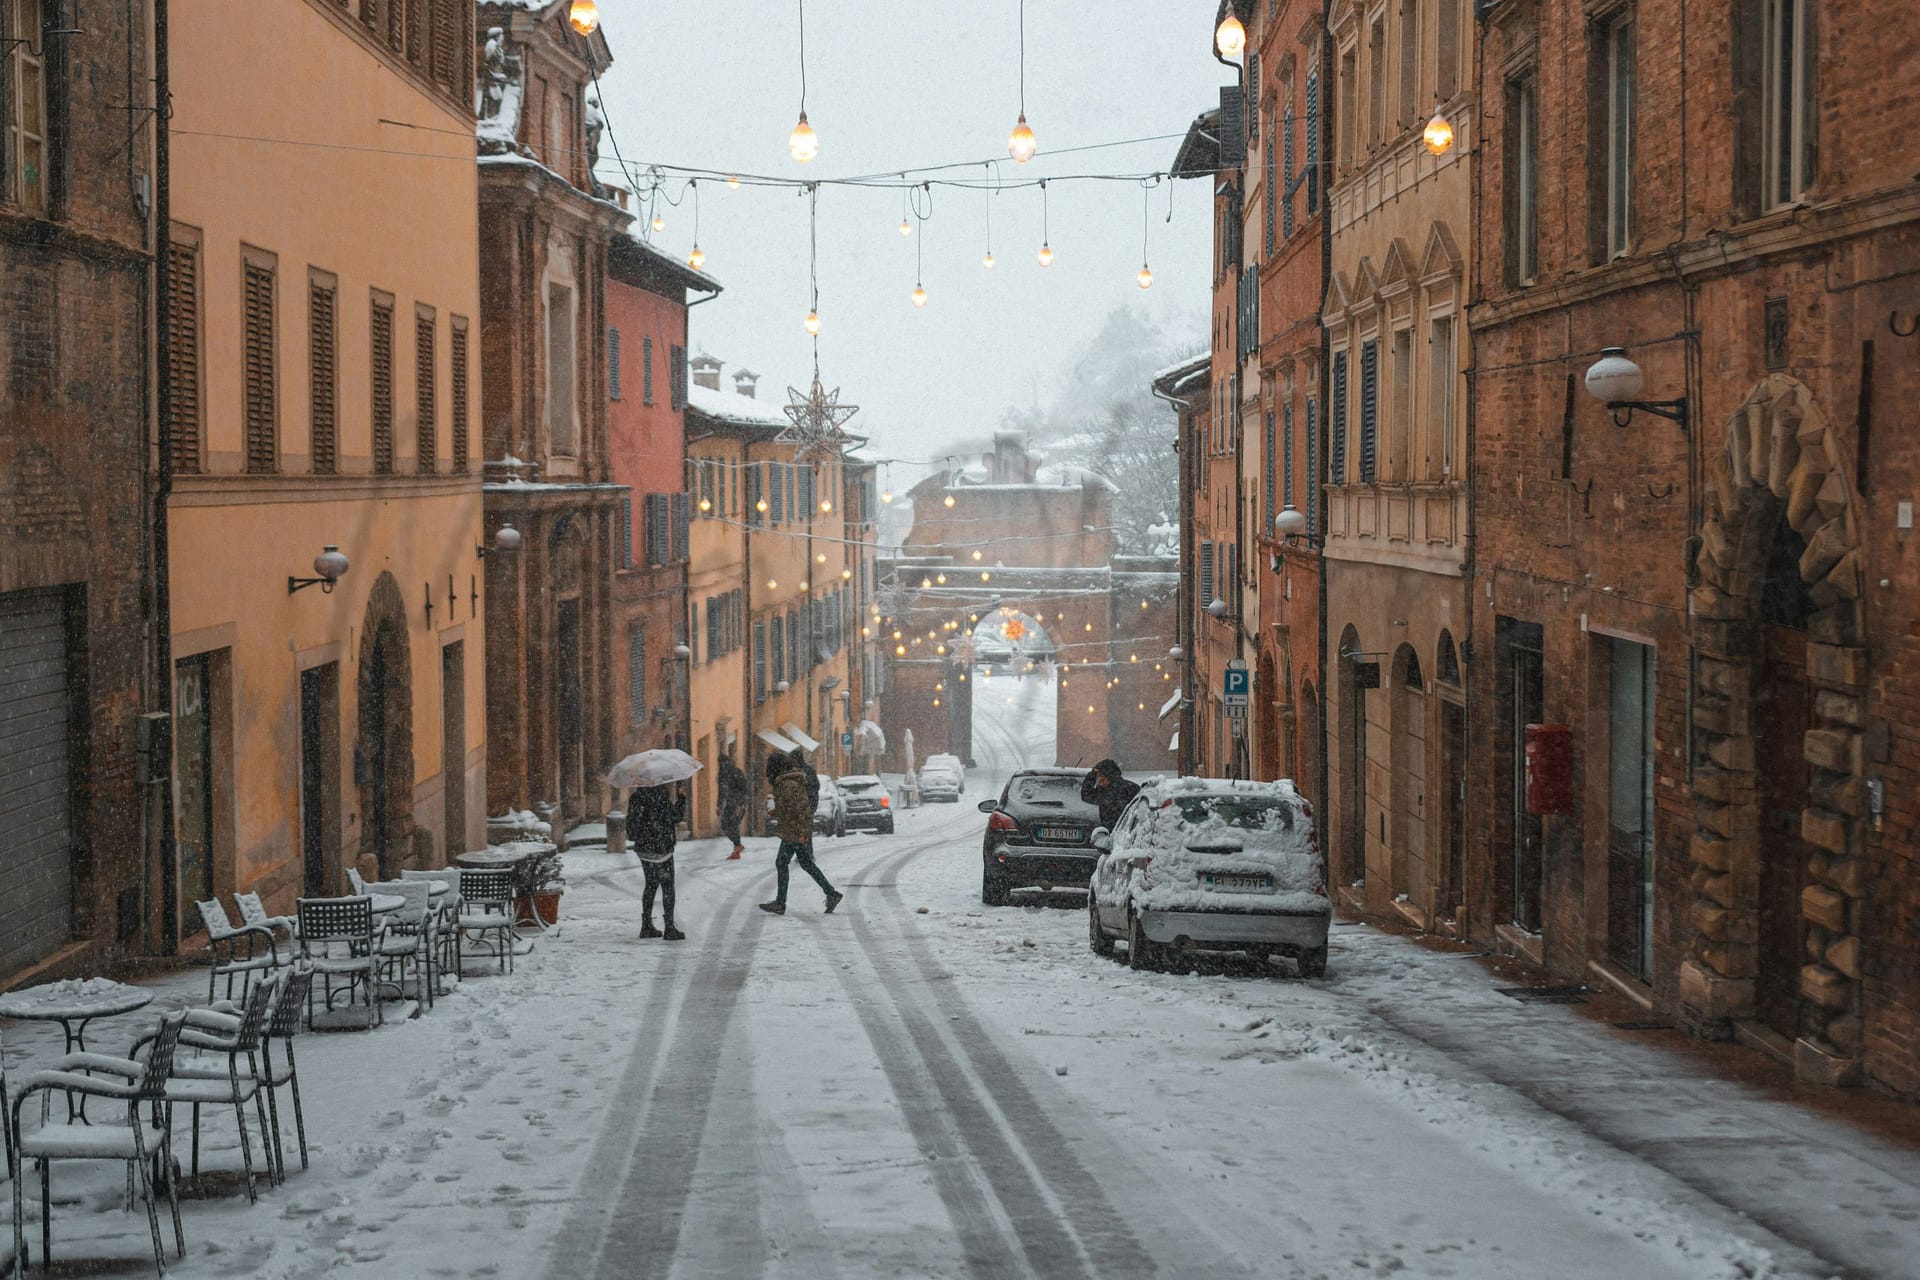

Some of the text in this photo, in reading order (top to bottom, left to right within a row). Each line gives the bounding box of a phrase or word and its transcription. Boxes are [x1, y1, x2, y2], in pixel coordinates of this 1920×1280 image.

[1229, 673, 1243, 691] P
[177, 675, 202, 717] ICA
[843, 734, 851, 744] P
